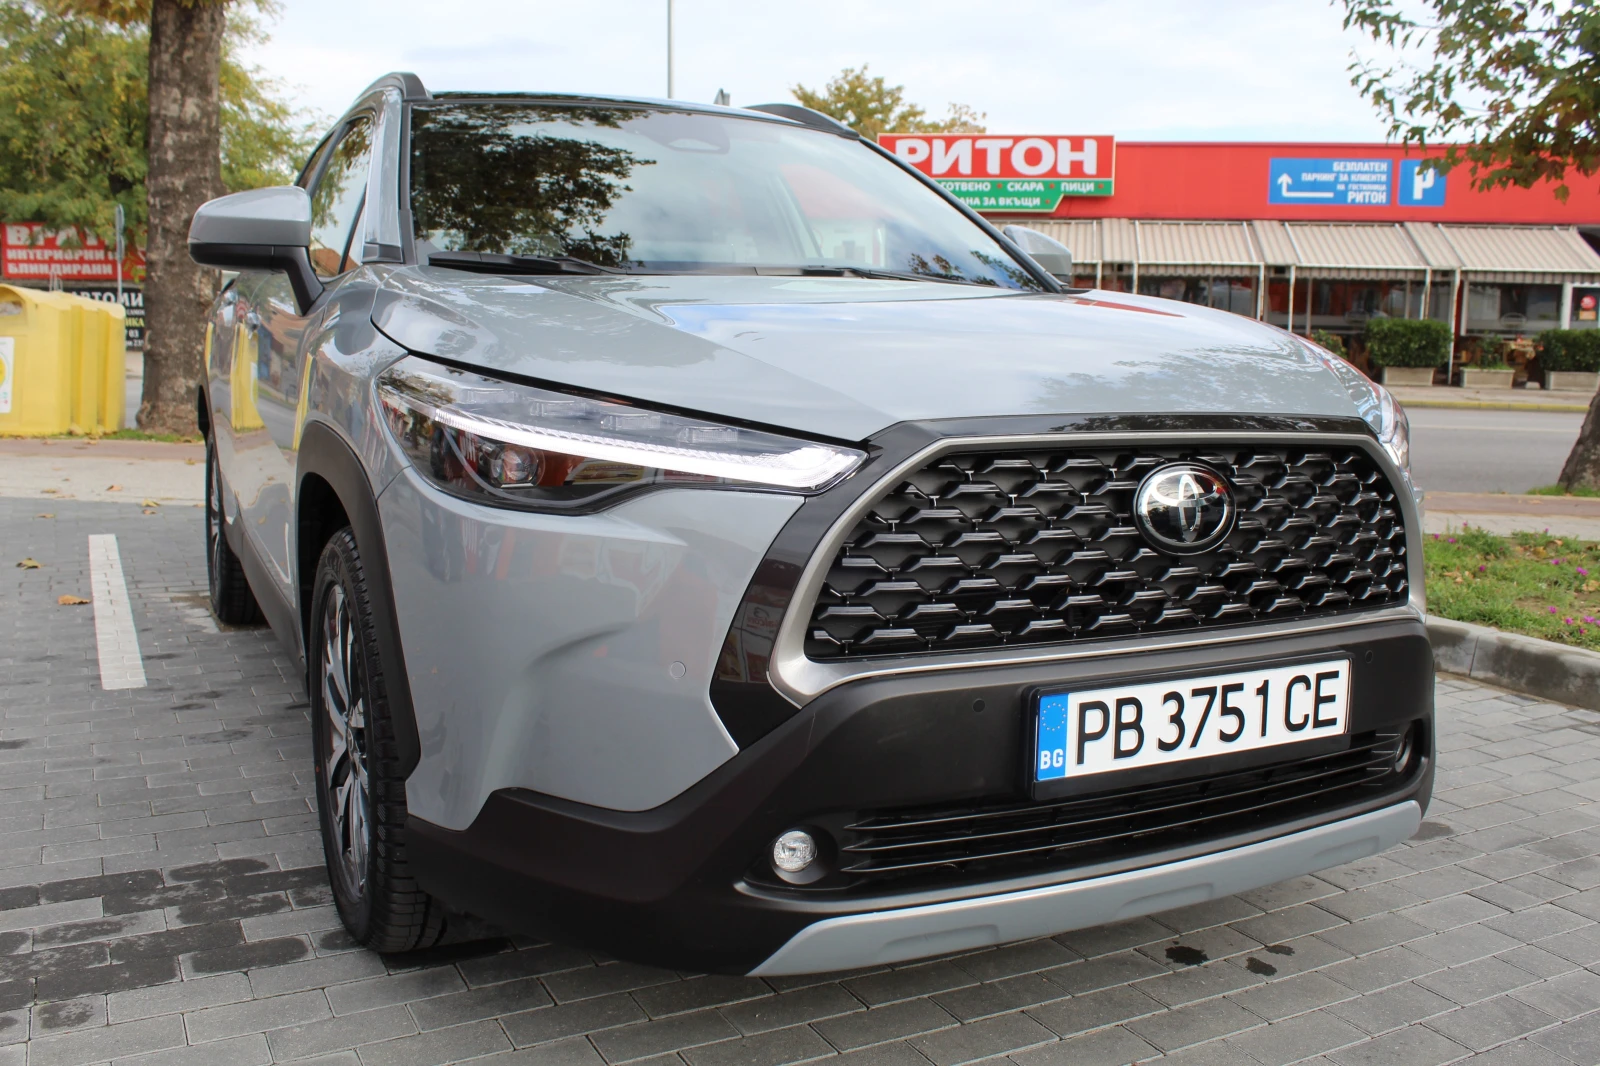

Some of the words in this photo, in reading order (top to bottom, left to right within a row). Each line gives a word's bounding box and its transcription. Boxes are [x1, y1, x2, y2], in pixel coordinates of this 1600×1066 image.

[895, 138, 1098, 176] РИТОН
[1333, 161, 1388, 172] БЕЗПЛАТЕН
[1301, 173, 1337, 182] ПАРКИНГ
[1339, 173, 1349, 182] ЗА
[1350, 173, 1388, 182] КЛИЕНТИ
[1007, 182, 1044, 192] СКАРА
[1061, 182, 1095, 193] ПИЦИ
[959, 197, 980, 206] АНА
[983, 197, 997, 207] ЗА
[999, 197, 1041, 208] ВКЪЩИ
[1347, 191, 1387, 204] РИТОН
[7, 262, 113, 275] БЛИНДИРАНИ
[1040, 750, 1064, 770] BG
[1076, 696, 1145, 765] PB
[1157, 679, 1270, 753] 3751
[1284, 670, 1340, 733] CE
